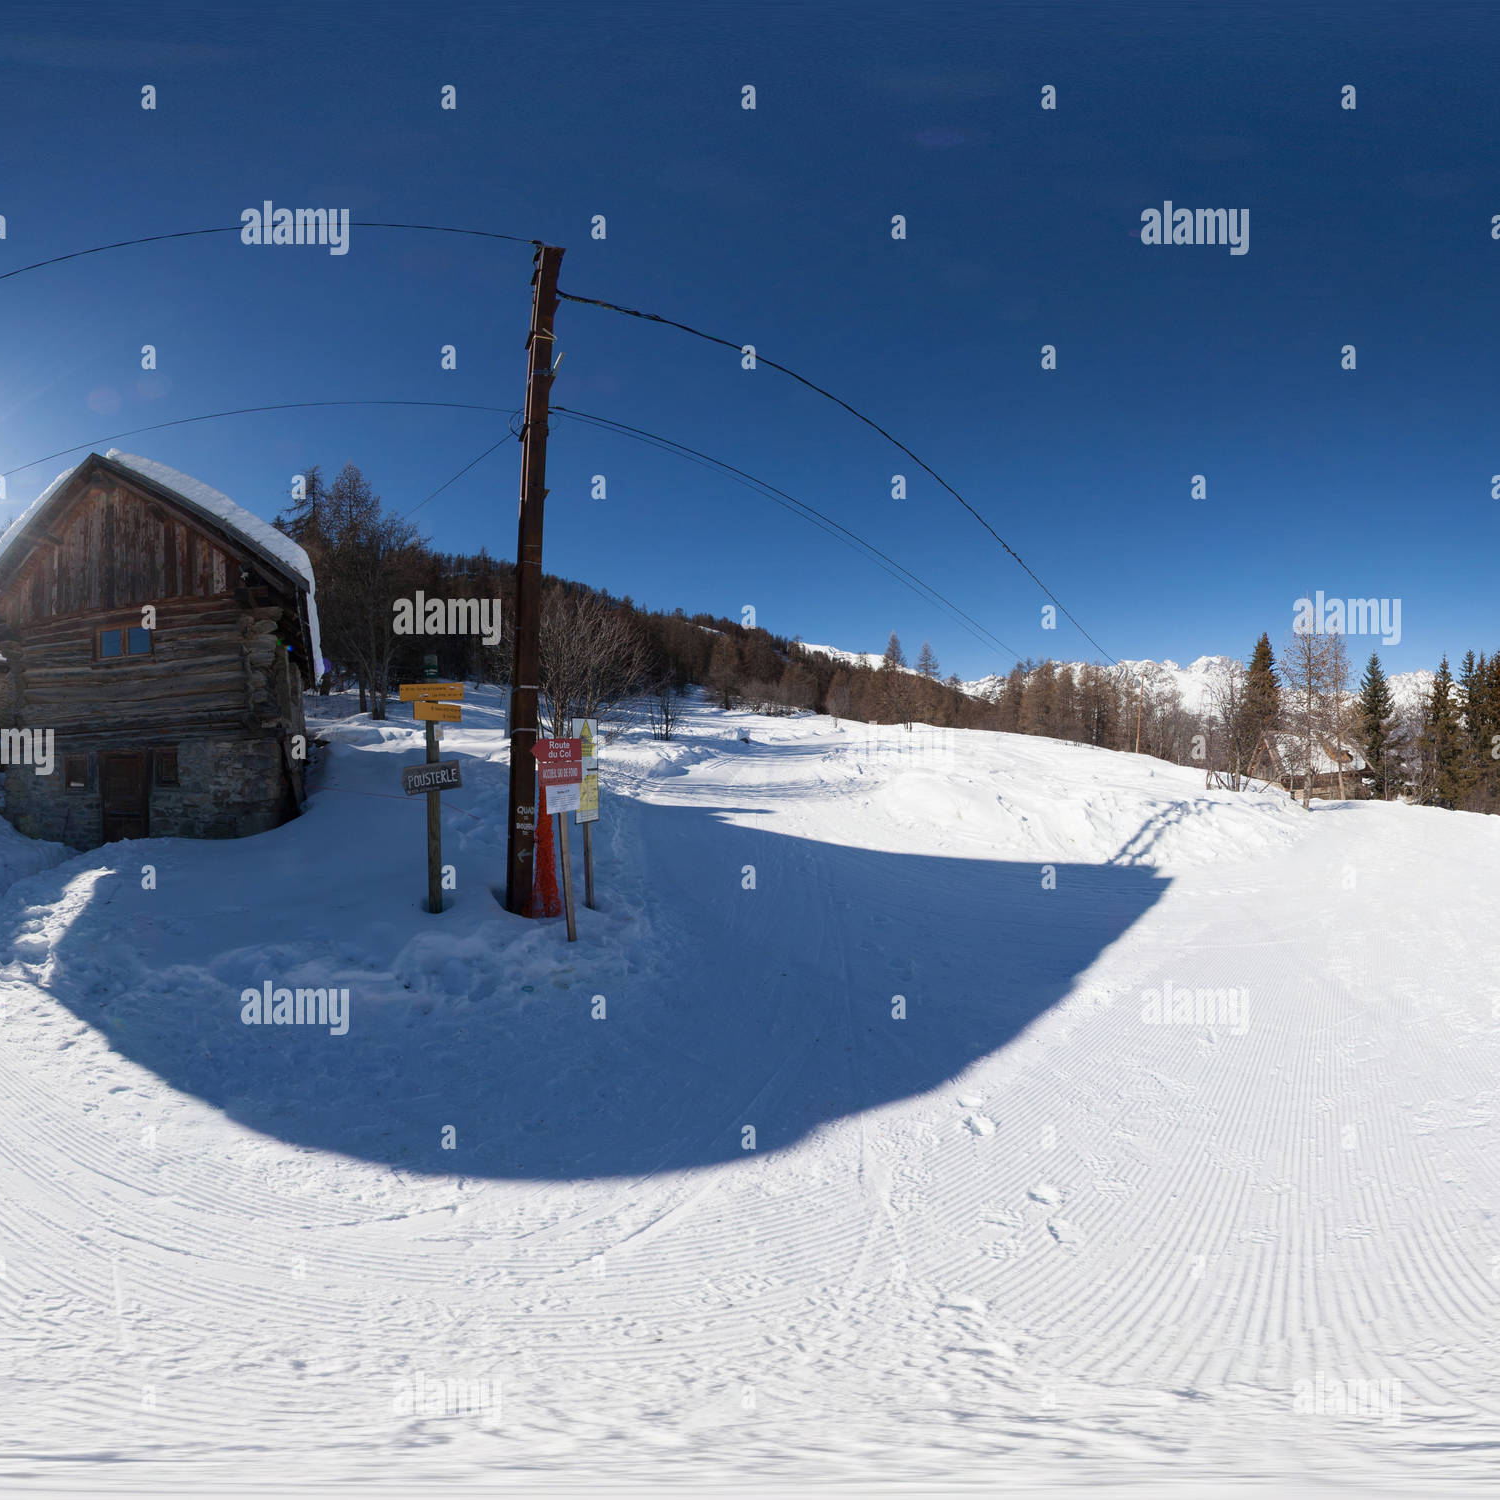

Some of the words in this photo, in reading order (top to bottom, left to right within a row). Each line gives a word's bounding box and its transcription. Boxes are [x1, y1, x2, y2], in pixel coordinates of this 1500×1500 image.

[549, 741, 570, 749] Route
[548, 750, 558, 758] du
[559, 749, 572, 758] Col
[563, 767, 568, 777] DE
[568, 767, 578, 777] FOND
[407, 768, 458, 789] POUSTERLE
